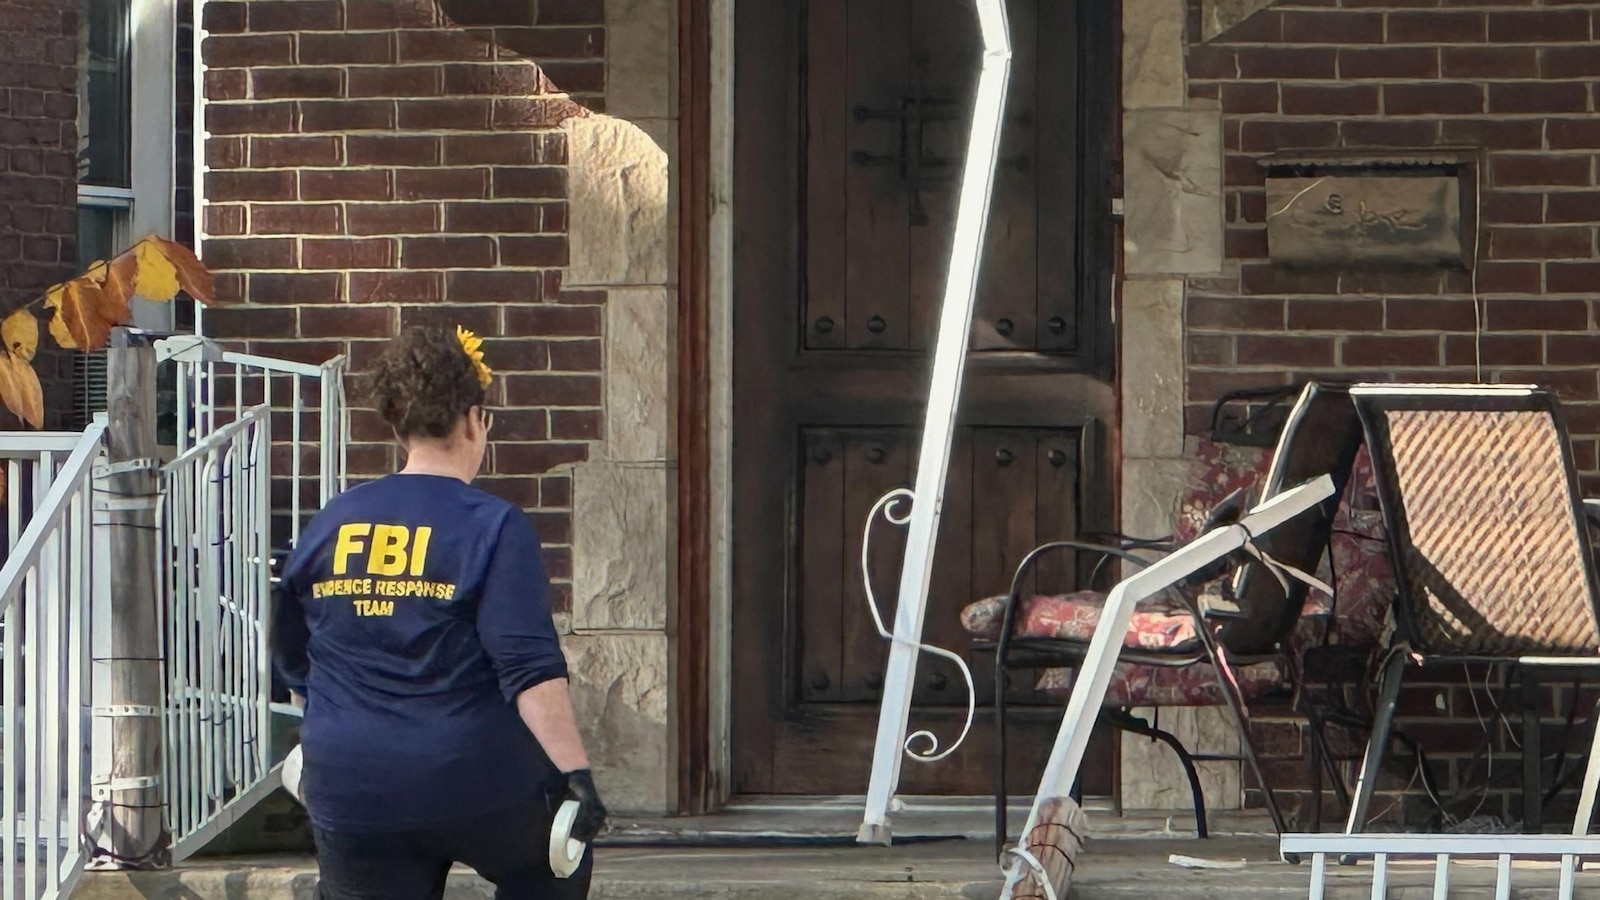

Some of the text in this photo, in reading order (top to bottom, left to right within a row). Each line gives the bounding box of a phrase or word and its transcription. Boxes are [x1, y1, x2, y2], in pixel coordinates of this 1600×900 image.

[333, 523, 432, 576] FBI
[375, 580, 456, 600] RESPONSE
[353, 600, 394, 616] TEAM
